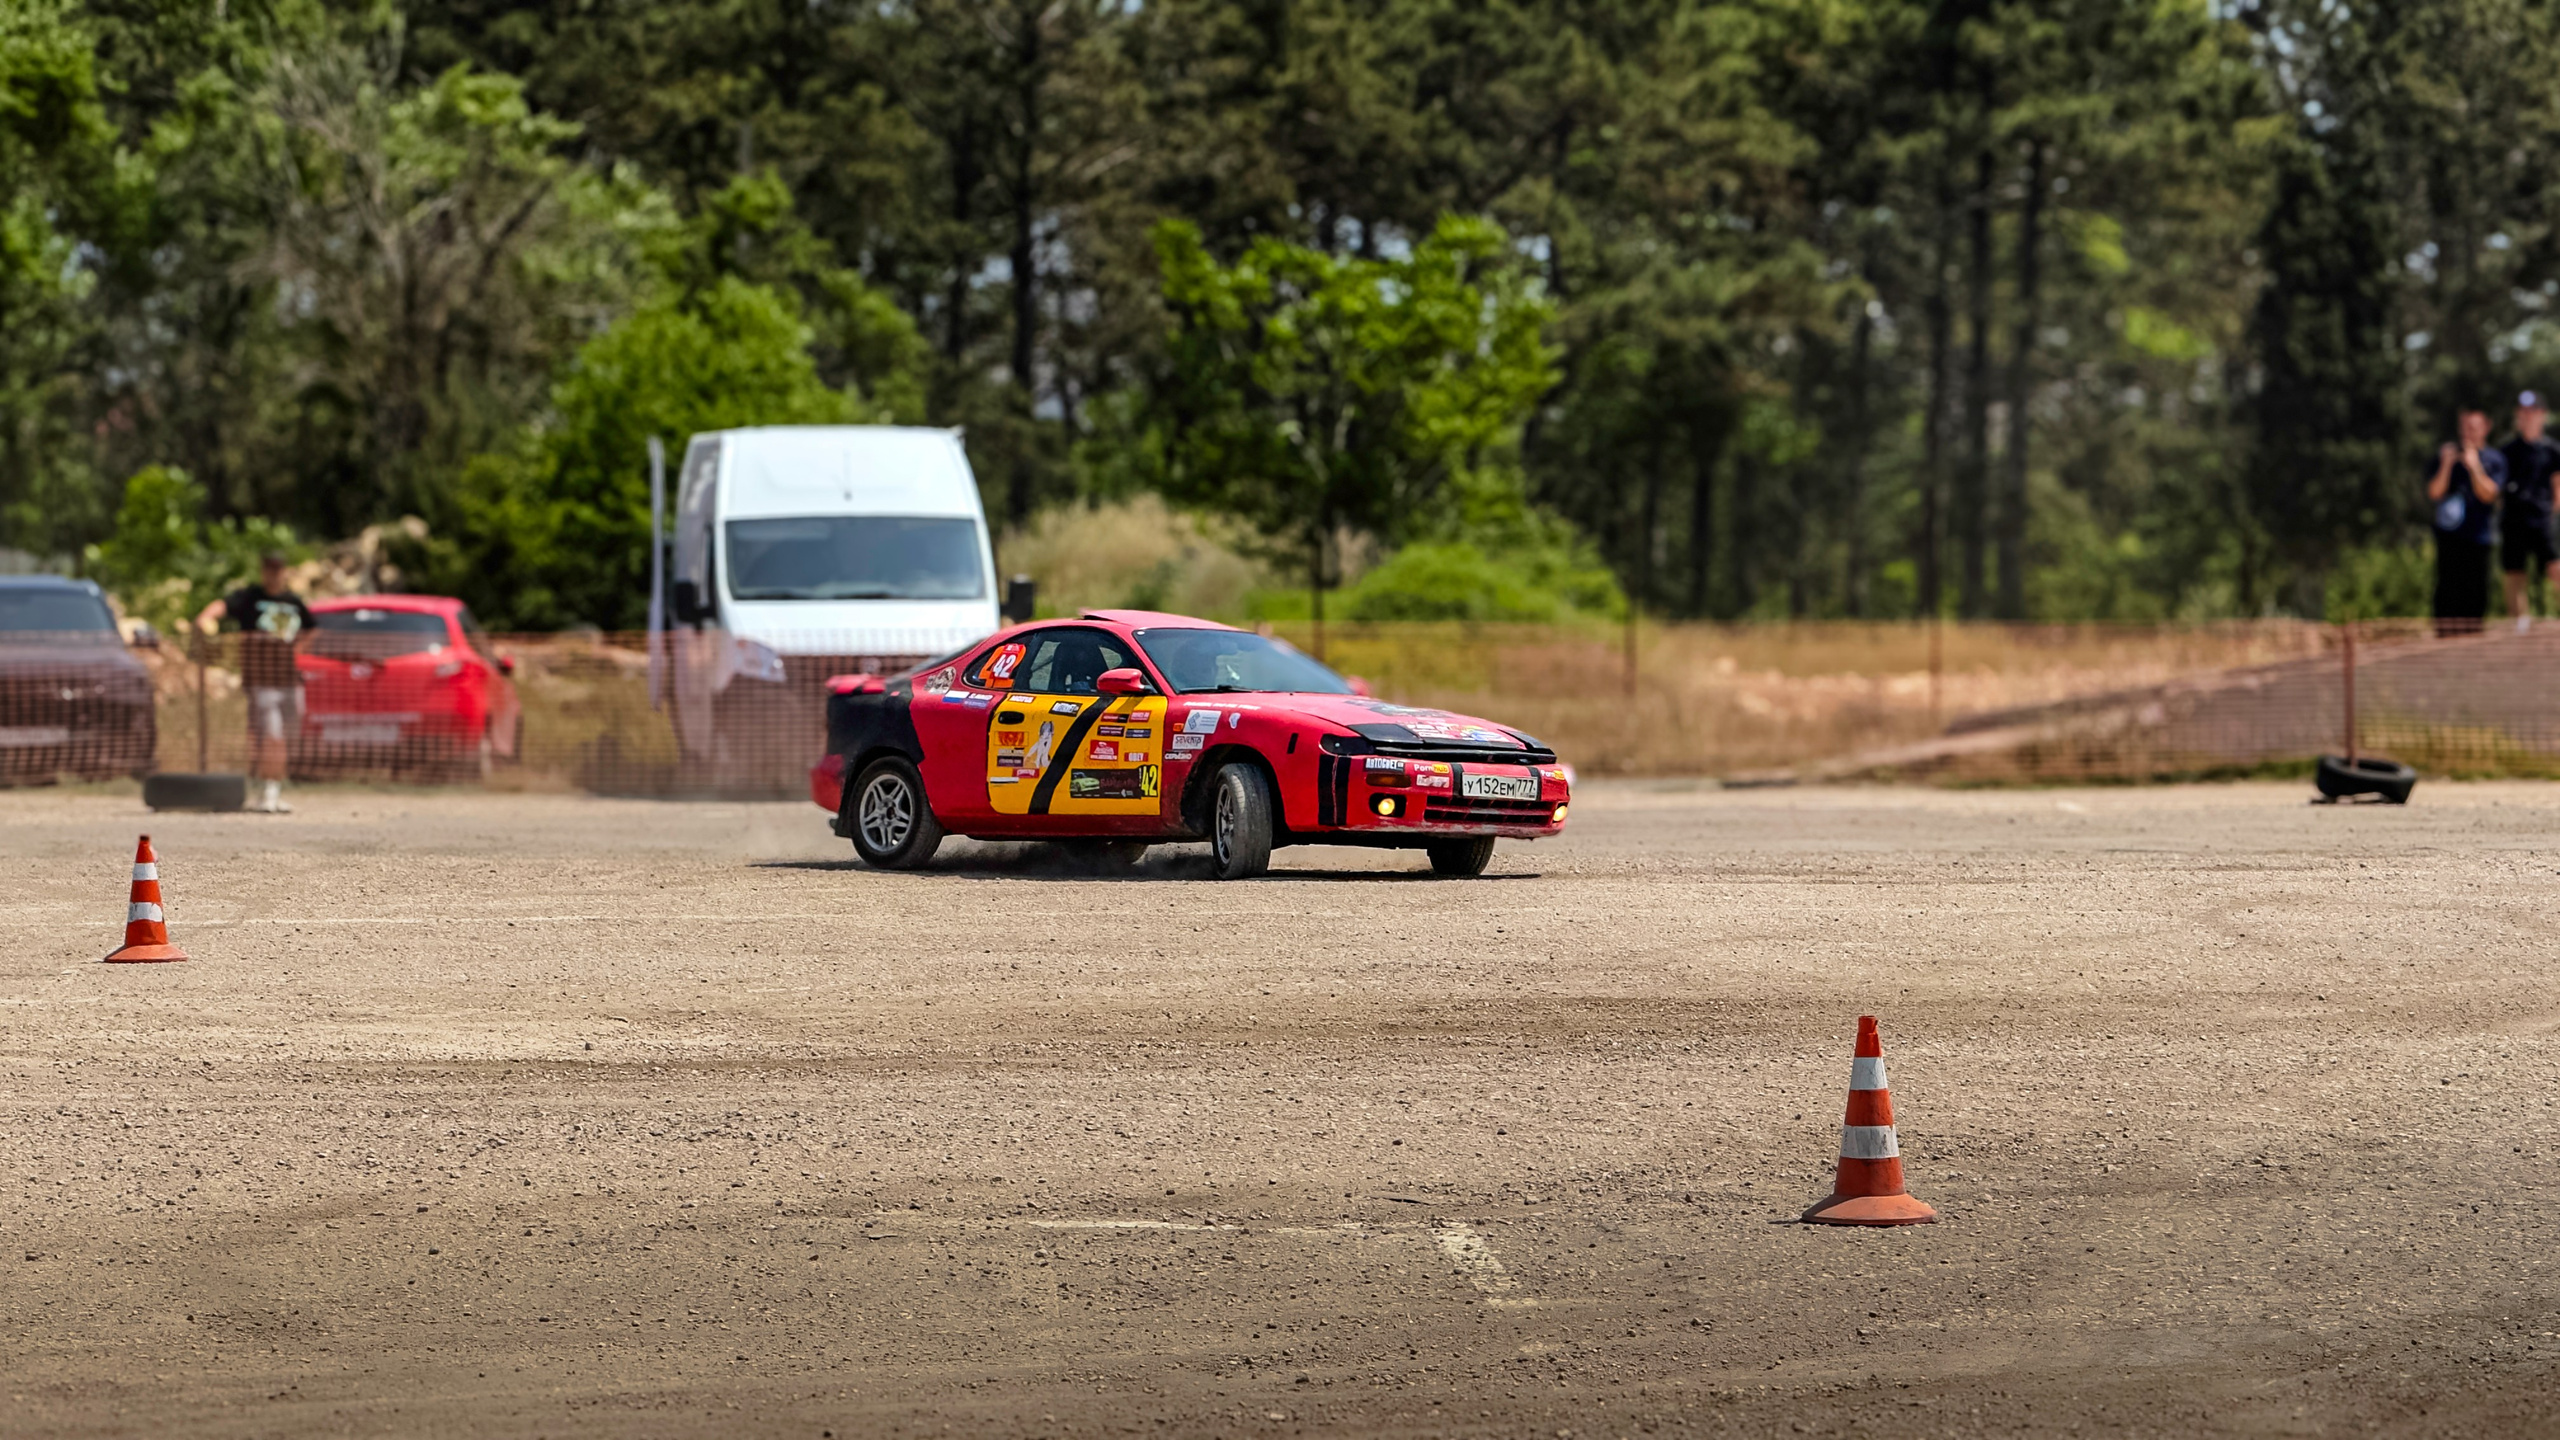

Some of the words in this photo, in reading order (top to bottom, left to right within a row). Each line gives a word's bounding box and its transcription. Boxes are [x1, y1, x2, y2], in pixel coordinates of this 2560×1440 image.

[992, 654, 1017, 678] 42
[1413, 763, 1449, 773] Pornhub
[1141, 765, 1157, 796] 42
[1517, 779, 1534, 793] 777
